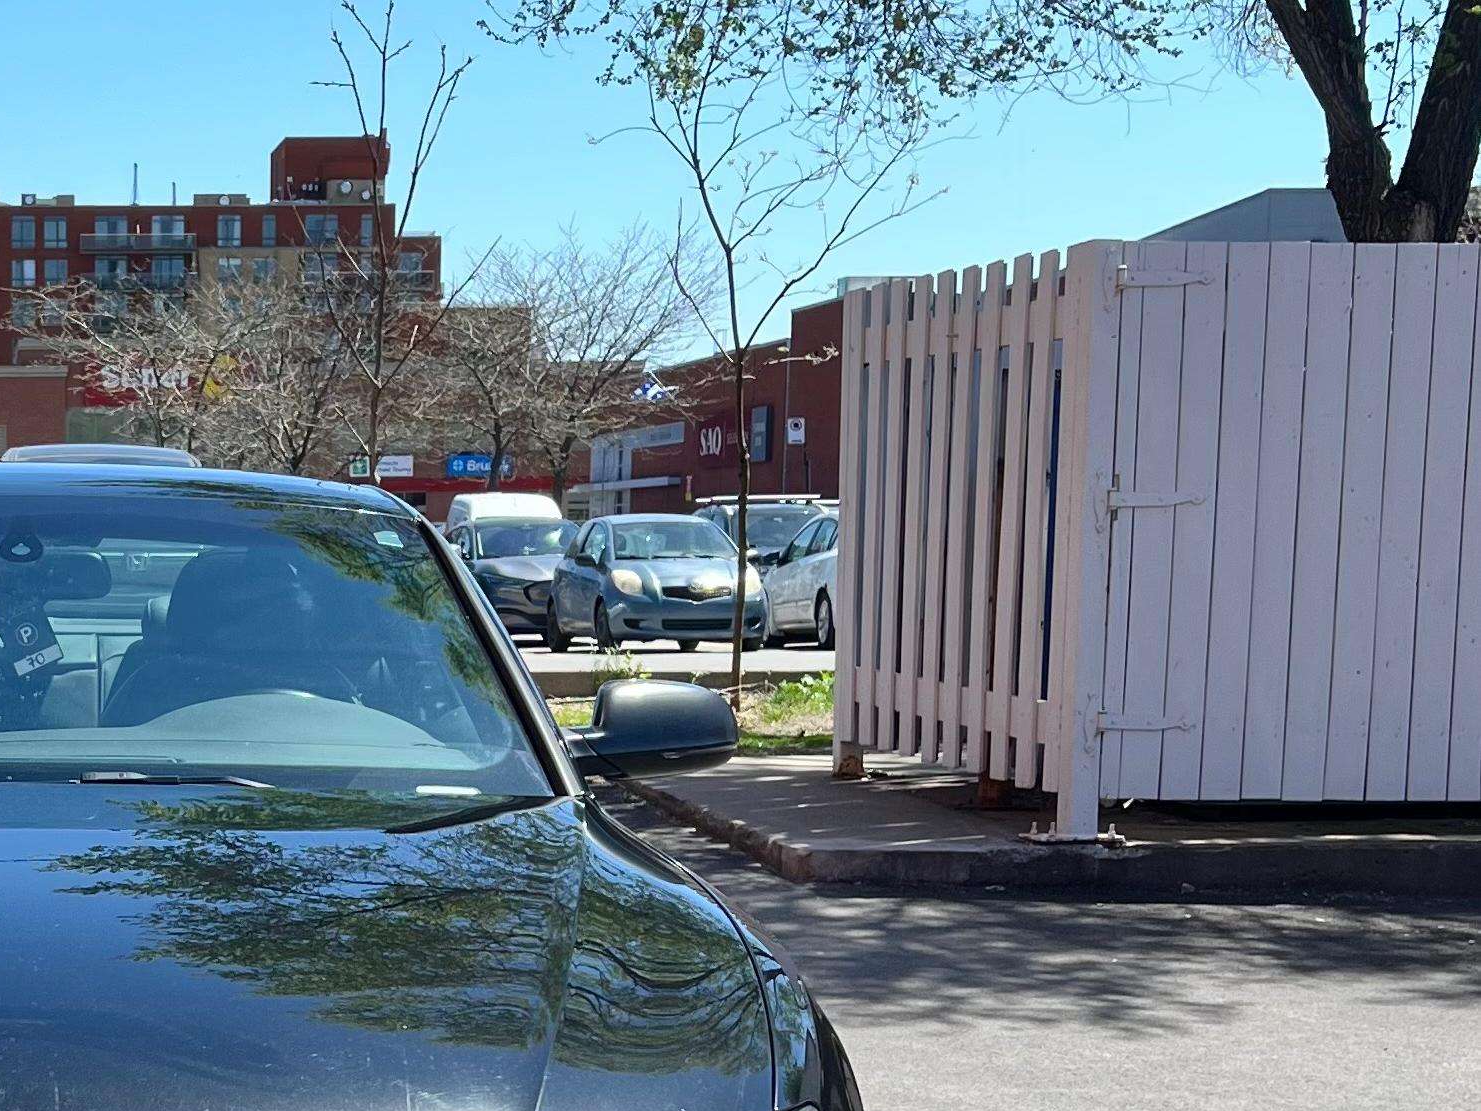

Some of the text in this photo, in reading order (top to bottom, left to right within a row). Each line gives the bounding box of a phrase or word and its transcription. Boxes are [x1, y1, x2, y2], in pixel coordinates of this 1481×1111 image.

[700, 426, 722, 456] SAQ
[20, 626, 32, 643] P
[26, 653, 46, 669] 70
